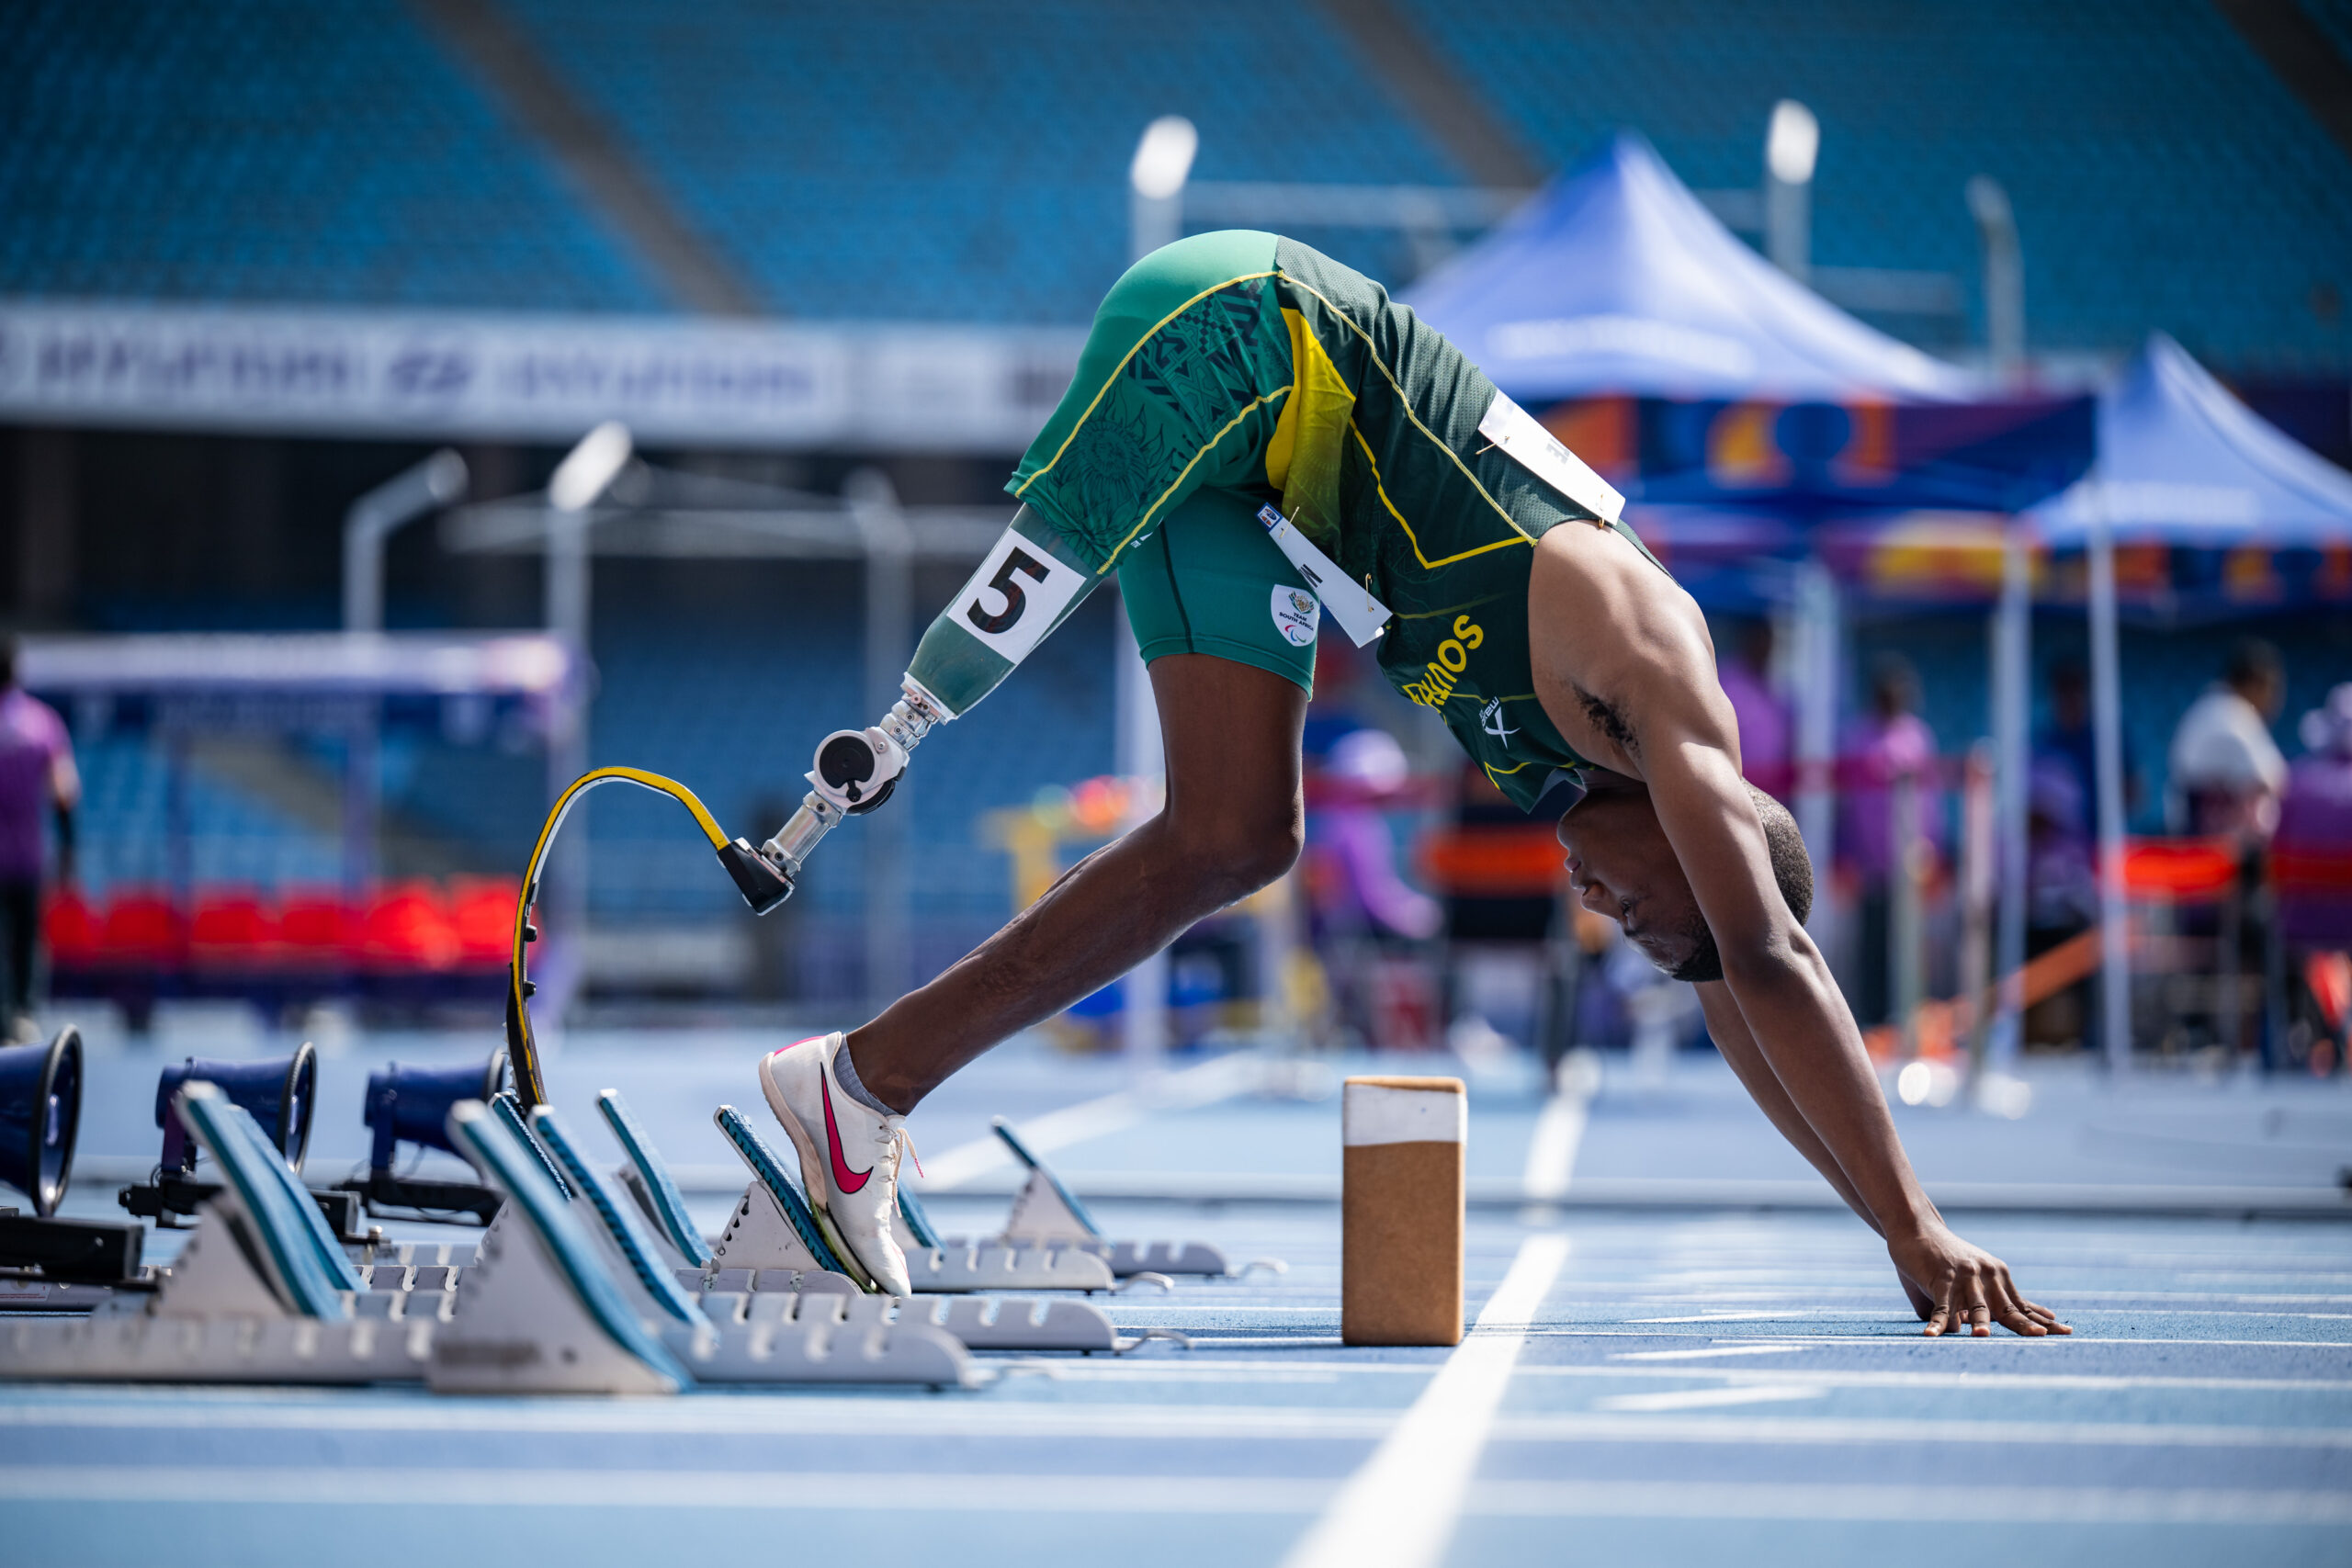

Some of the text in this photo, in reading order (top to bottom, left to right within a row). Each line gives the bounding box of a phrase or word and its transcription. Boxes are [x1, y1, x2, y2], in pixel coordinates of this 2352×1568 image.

[967, 546, 1051, 635] 5
[1279, 612, 1314, 631] SOUTH AFRICA
[1293, 612, 1307, 622] TEAM
